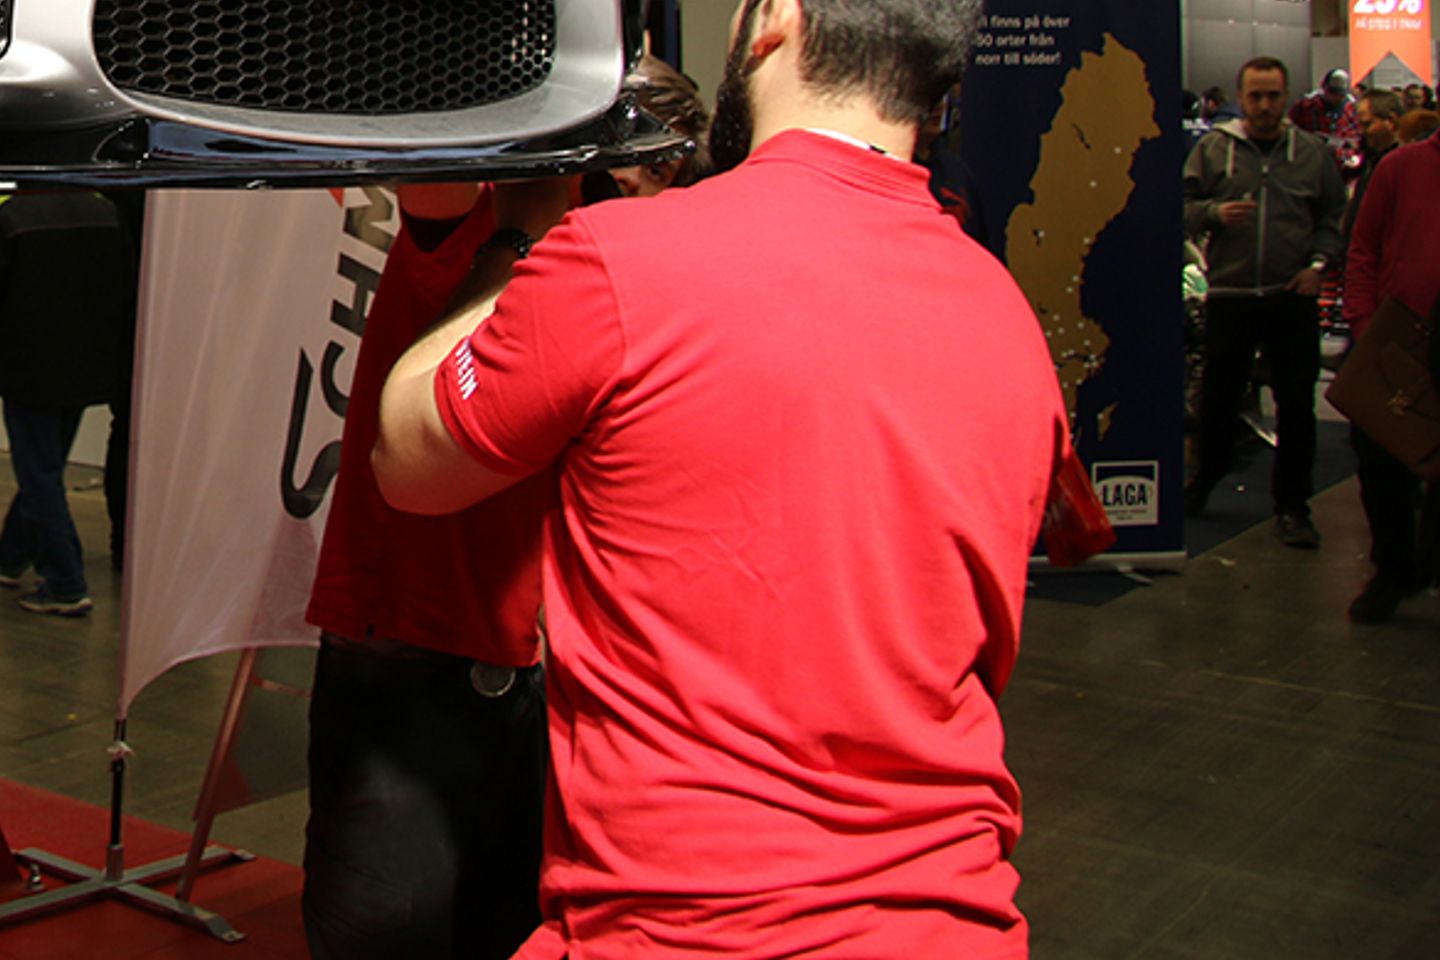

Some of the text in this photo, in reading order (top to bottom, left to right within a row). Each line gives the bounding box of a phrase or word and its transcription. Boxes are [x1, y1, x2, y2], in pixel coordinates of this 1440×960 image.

[990, 14, 1022, 28] finns
[1024, 14, 1040, 31] på
[1043, 14, 1071, 28] över
[995, 34, 1027, 48] orter
[1029, 33, 1056, 47] från
[975, 53, 1001, 65] norr
[1004, 51, 1020, 65] till
[1102, 483, 1149, 507] LAGA
